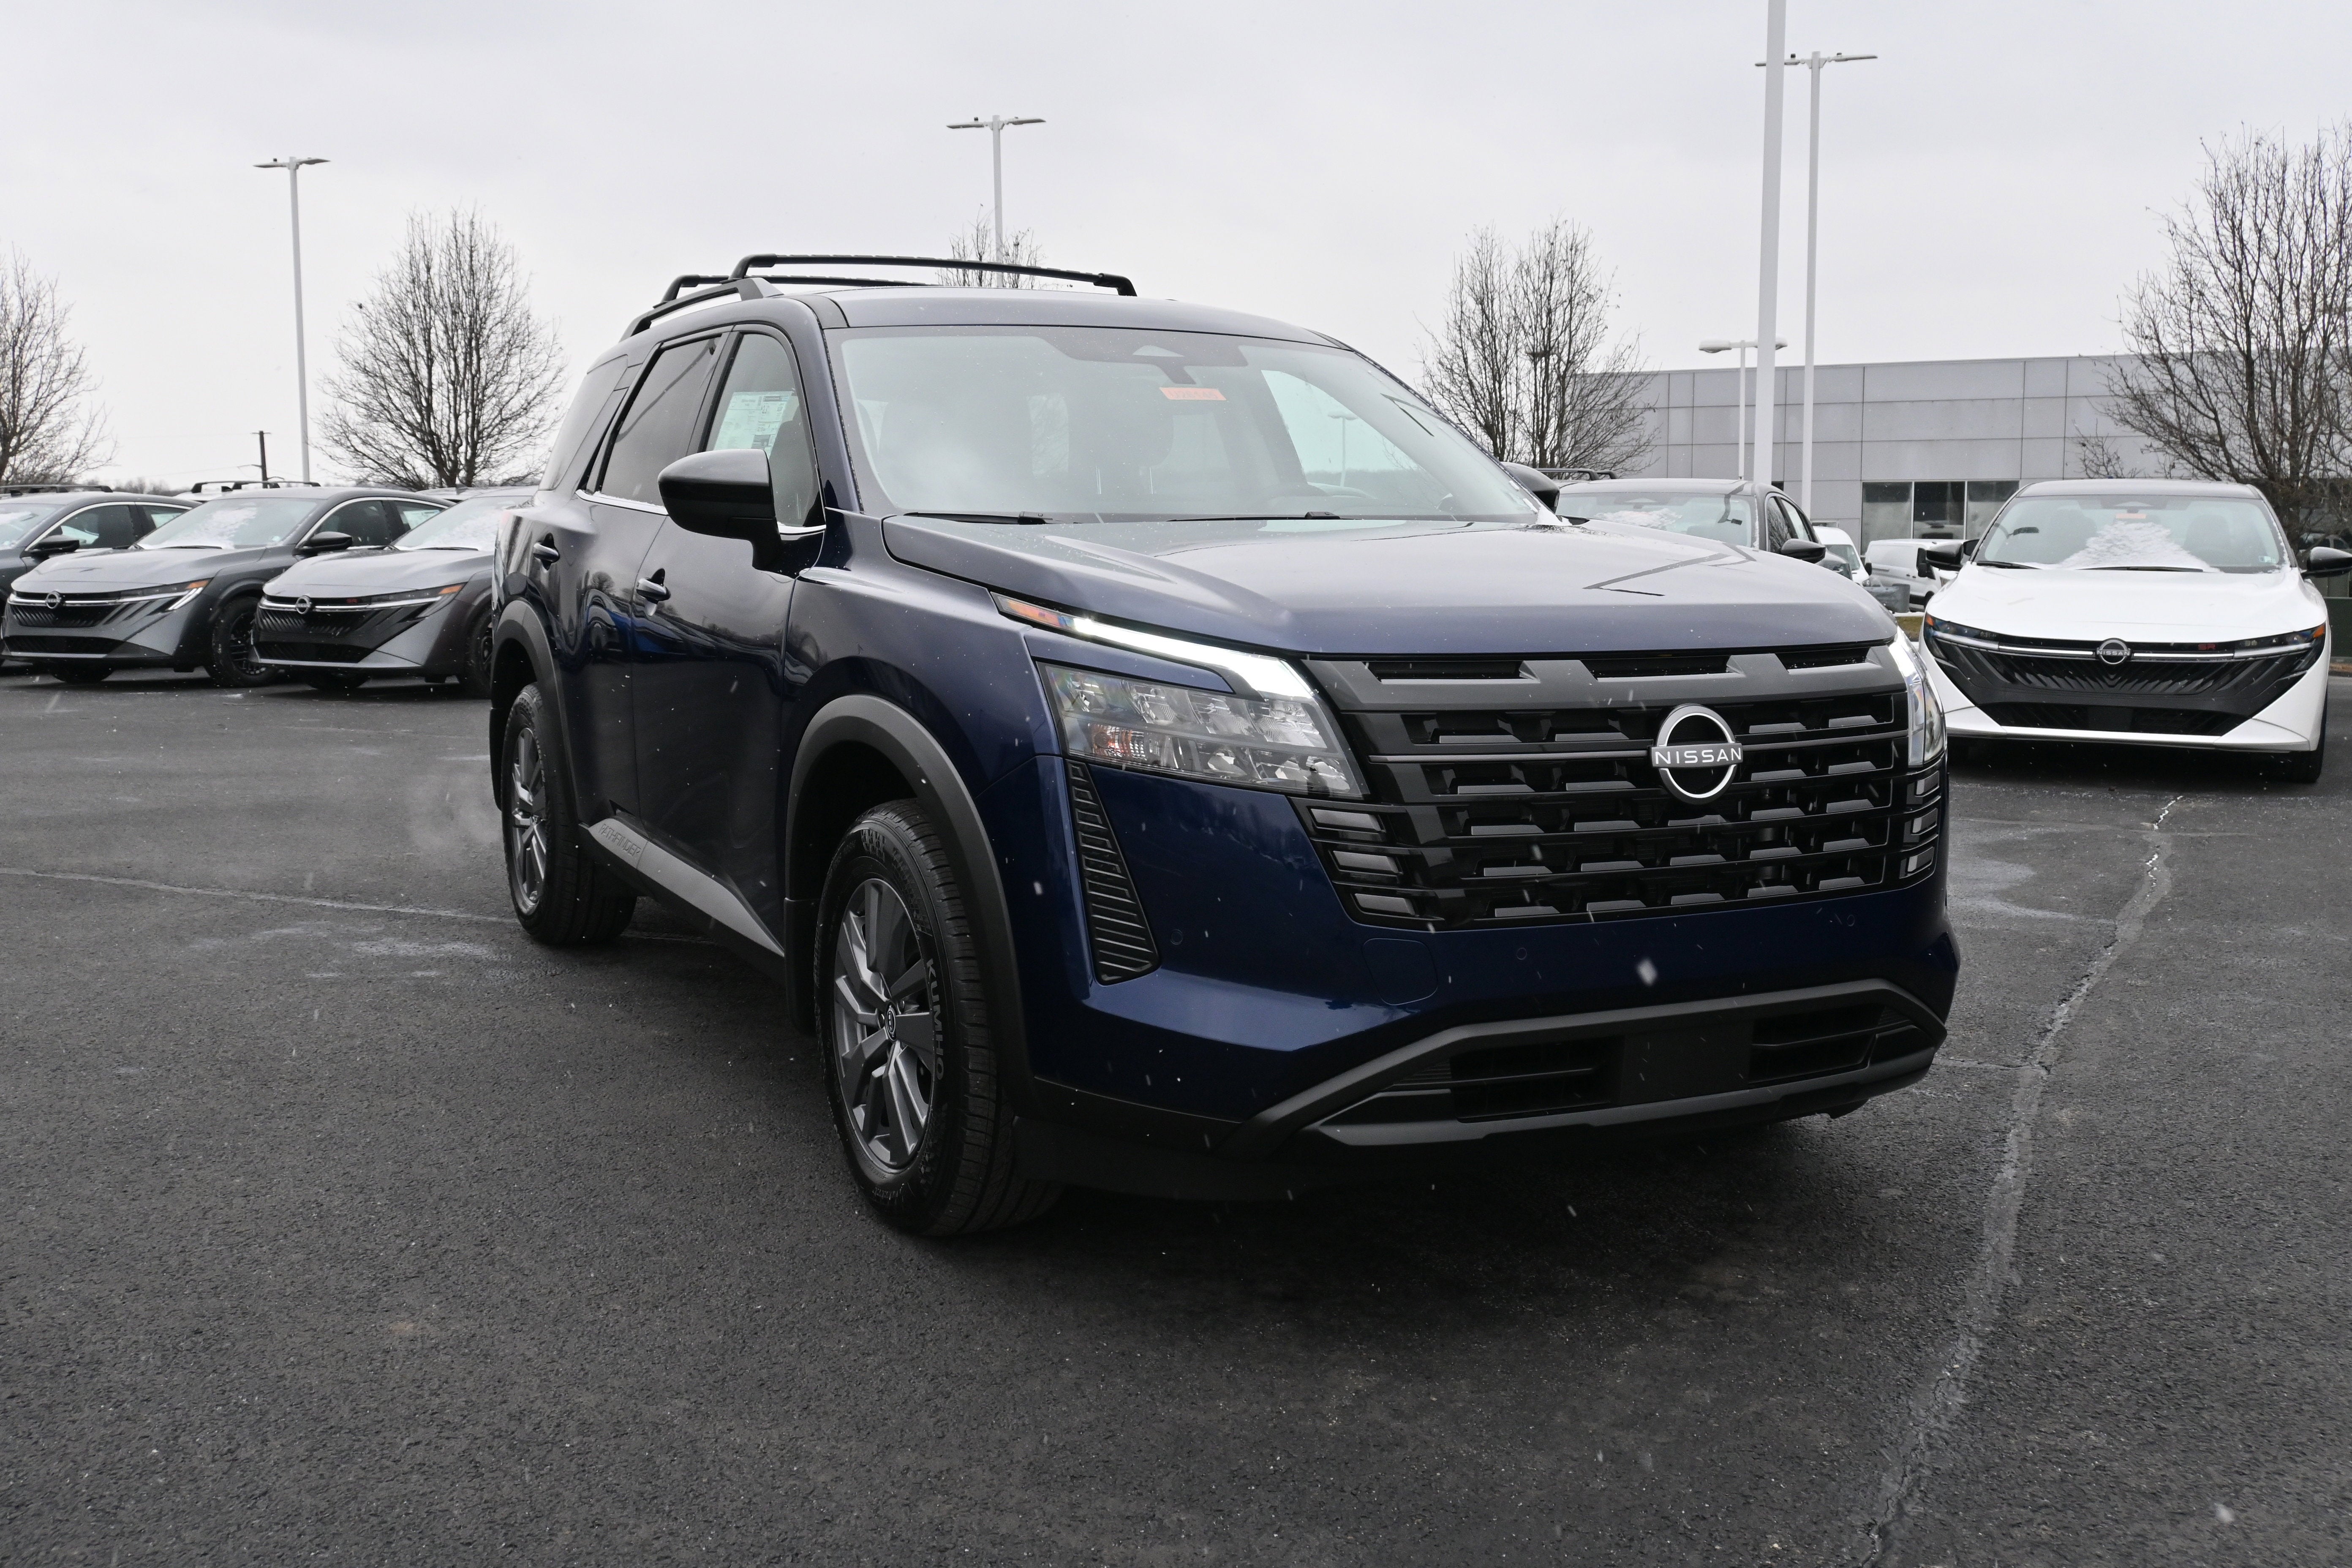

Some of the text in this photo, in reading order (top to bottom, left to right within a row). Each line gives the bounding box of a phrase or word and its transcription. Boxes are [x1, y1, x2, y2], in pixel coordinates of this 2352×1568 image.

[1655, 747, 1742, 765] NISSAN
[598, 823, 642, 857] PATHFINDER
[926, 958, 944, 1081] KUMHO
